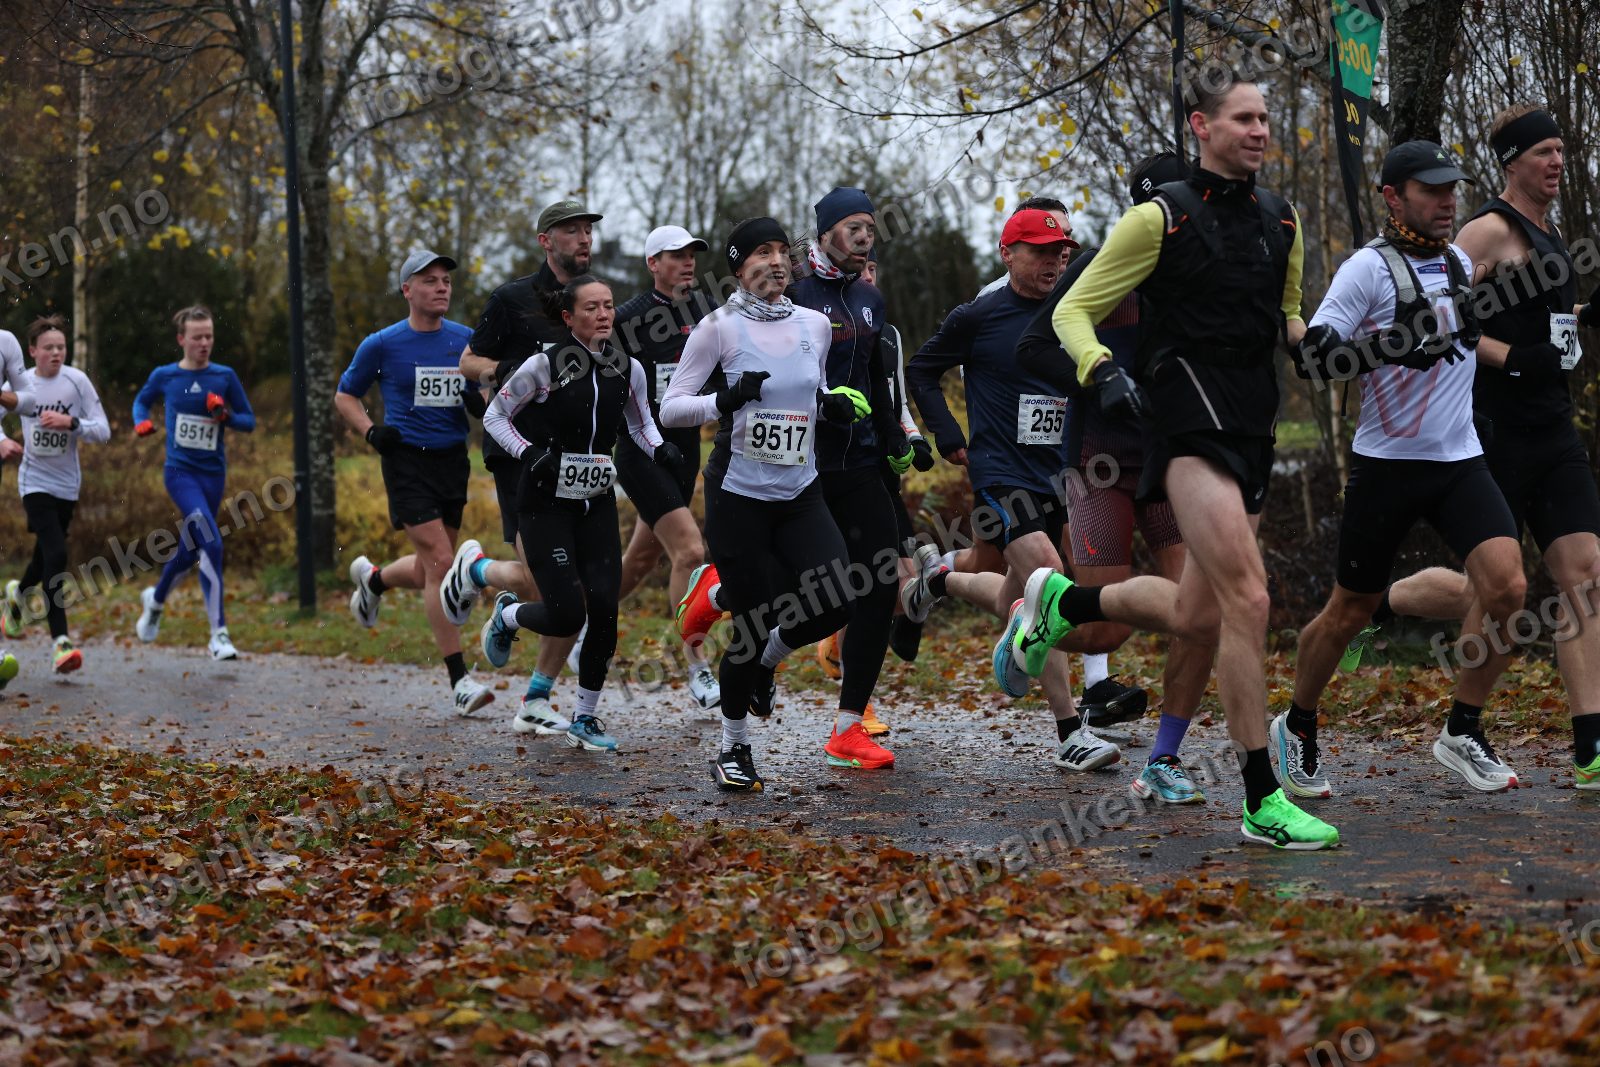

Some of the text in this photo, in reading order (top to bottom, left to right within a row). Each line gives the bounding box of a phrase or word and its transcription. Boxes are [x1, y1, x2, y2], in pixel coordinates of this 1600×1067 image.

[420, 377, 461, 397] 9513
[753, 412, 809, 423] NORGESTESTEN
[1030, 408, 1066, 433] 255
[32, 430, 69, 449] 9508
[179, 422, 215, 442] 9514
[751, 422, 808, 452] 9517
[564, 464, 612, 489] 9495
